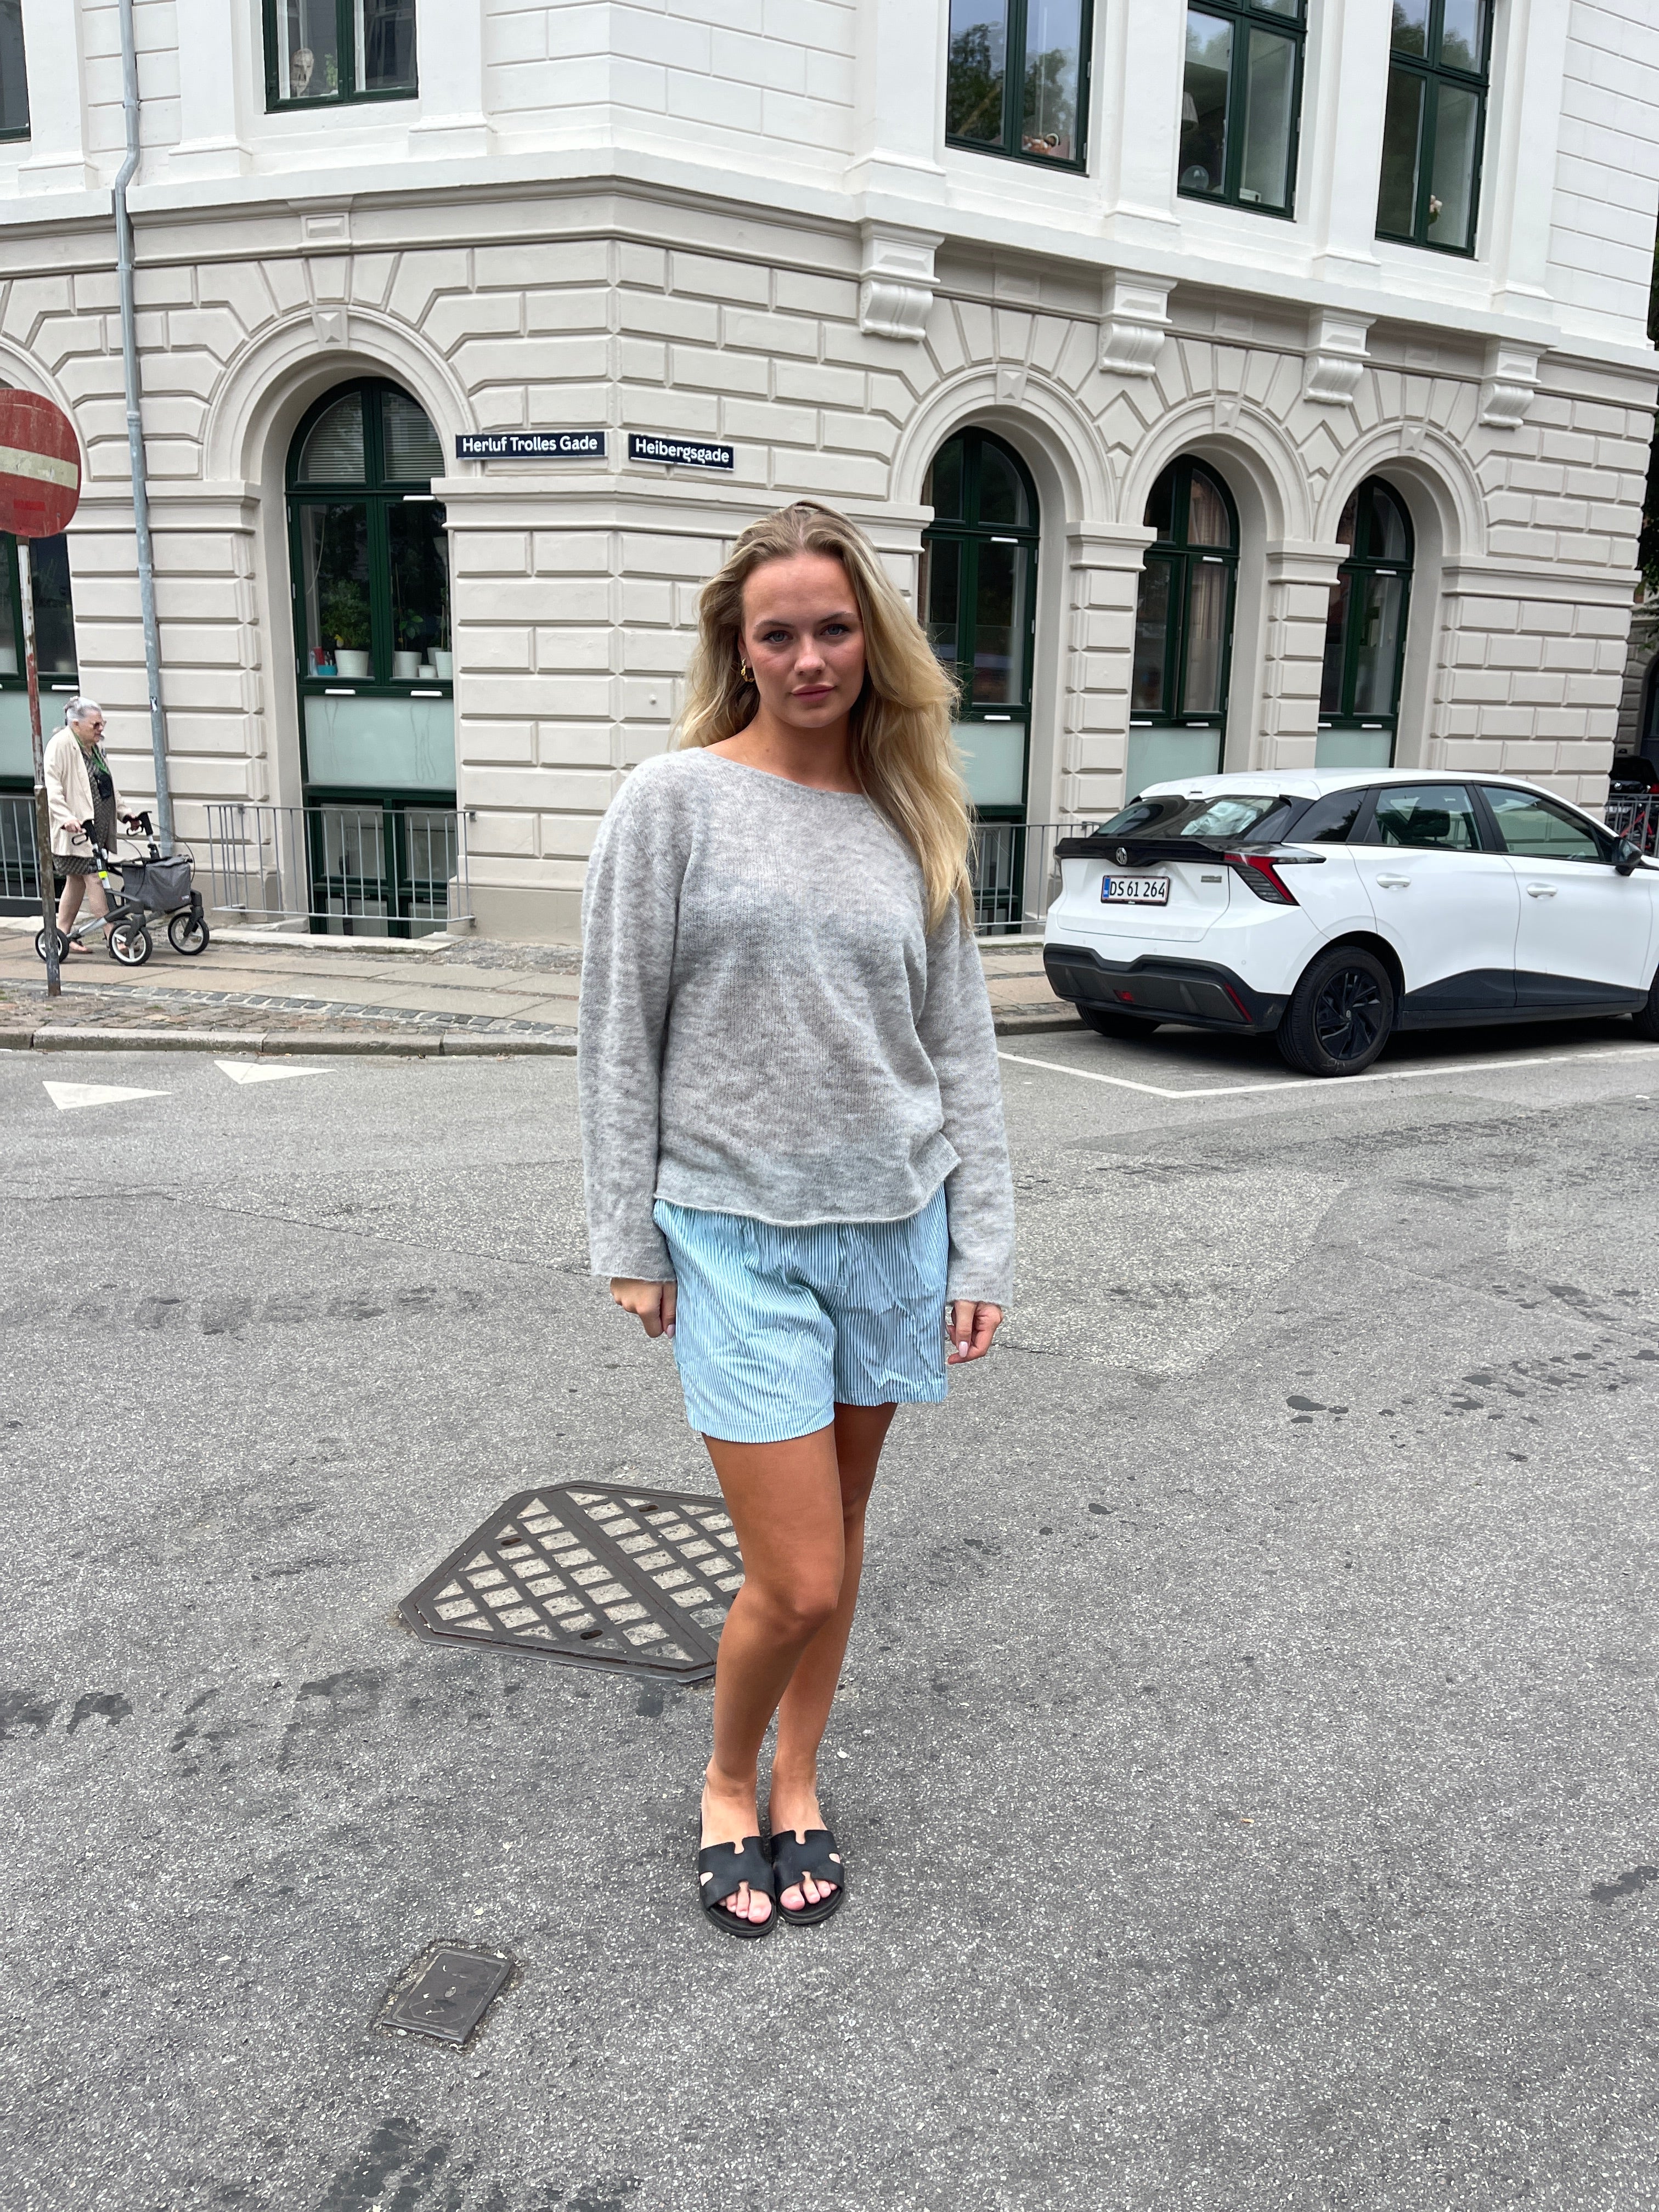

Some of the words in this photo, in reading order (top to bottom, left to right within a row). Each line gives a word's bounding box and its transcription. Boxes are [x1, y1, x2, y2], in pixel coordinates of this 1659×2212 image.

[462, 437, 507, 452] Herluf
[510, 436, 557, 452] Trolles
[560, 436, 598, 451] Gade
[635, 438, 730, 464] Heibergsgade
[1109, 881, 1125, 896] DS
[1127, 881, 1139, 897] 61
[1143, 881, 1165, 898] 264
